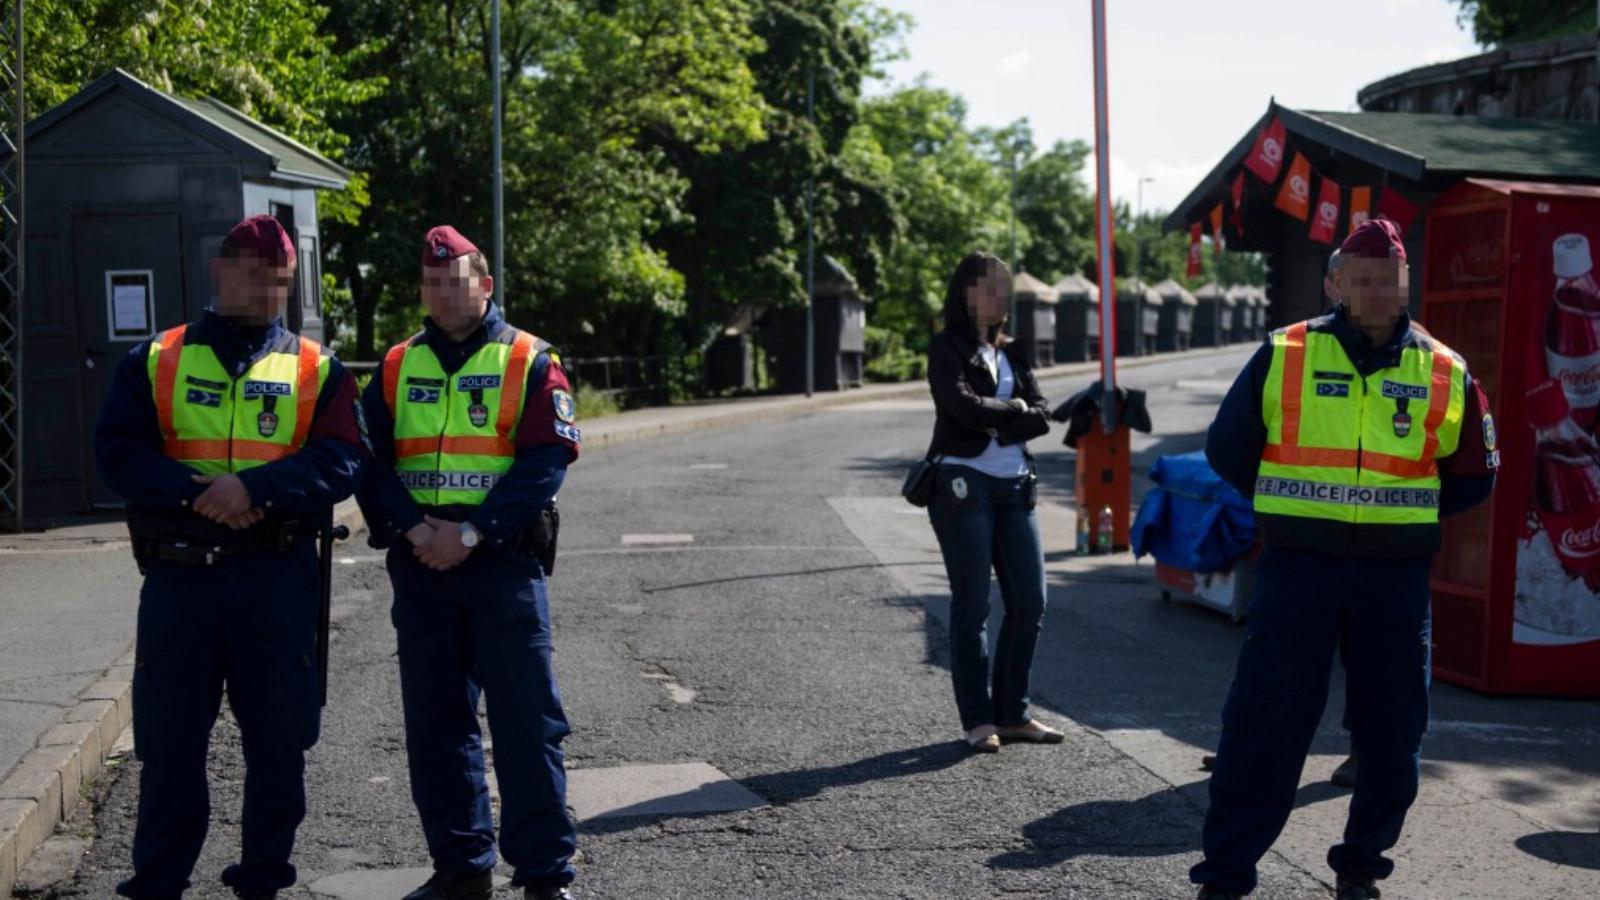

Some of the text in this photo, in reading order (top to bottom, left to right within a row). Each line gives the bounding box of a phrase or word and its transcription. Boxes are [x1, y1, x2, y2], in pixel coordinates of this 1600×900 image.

[245, 382, 290, 394] POLICE
[458, 376, 499, 388] POLICE
[1383, 382, 1427, 397] POLICE
[1278, 481, 1340, 500] POLICE
[1347, 488, 1409, 503] POLICE
